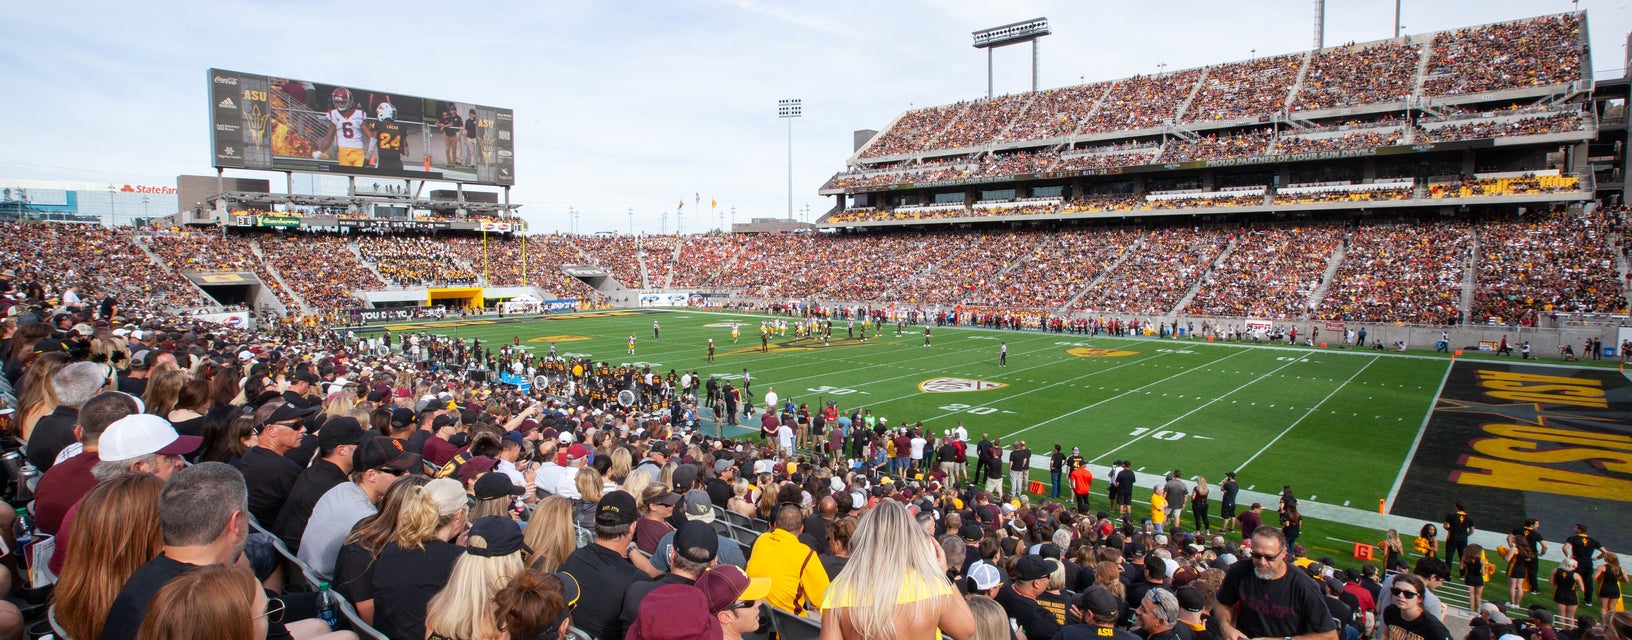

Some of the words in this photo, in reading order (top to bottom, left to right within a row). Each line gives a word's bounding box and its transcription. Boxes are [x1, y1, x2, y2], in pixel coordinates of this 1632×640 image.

[244, 90, 267, 101] ASU
[478, 119, 495, 128] ASU
[342, 122, 354, 139] 6
[379, 132, 400, 150] 24
[1236, 156, 1275, 165] PARTNER
[1291, 151, 1318, 161] YOUR
[1320, 150, 1340, 159] SUN
[1341, 148, 1377, 158] DEVILS
[136, 185, 160, 194] State
[361, 311, 379, 319] YOU
[938, 403, 999, 415] 20
[1129, 427, 1187, 441] 10
[1031, 481, 1041, 493] 10
[1357, 546, 1369, 559] G
[1097, 628, 1114, 637] ASU
